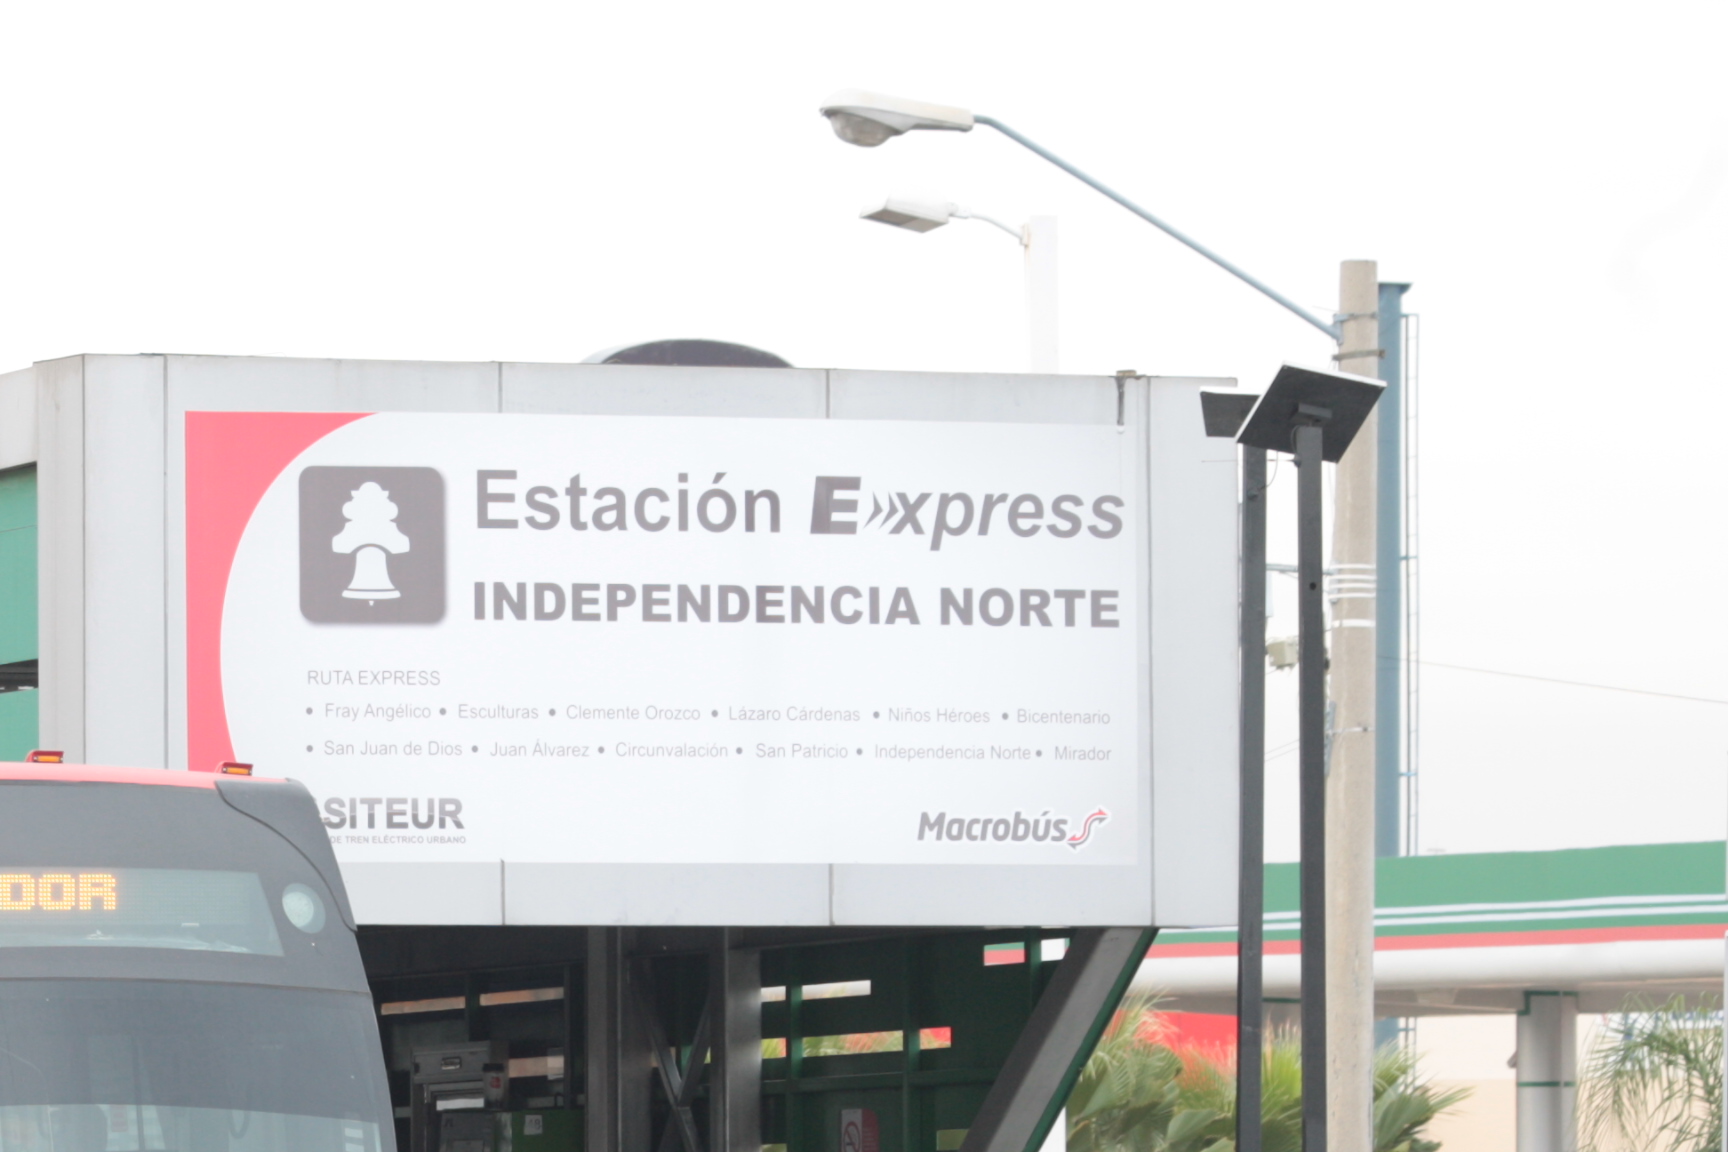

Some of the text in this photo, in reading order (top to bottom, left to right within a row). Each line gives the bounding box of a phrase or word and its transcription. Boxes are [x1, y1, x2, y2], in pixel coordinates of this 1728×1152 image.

[475, 468, 782, 534] Estación
[473, 581, 1121, 630] INDEPENDENCIA NORTE
[307, 669, 441, 686] RUTA EXPRESS
[324, 702, 432, 722] Fray Angélico
[457, 703, 540, 720] Esculturas
[565, 704, 702, 721] Clemente Orozco
[728, 705, 861, 722] Lázaro Cárdenas
[888, 706, 991, 724] Niños Héroes
[1016, 708, 1112, 725] Bicentenario
[323, 739, 463, 757] San Juan de Dios
[489, 738, 590, 758] Juan Álvarez
[615, 741, 729, 759] Circunvalación
[755, 742, 849, 759] San Patricio
[874, 743, 1032, 763] Independencia Norte
[1054, 745, 1113, 762] Mirador
[323, 797, 465, 831] SITEUR
[917, 809, 1068, 843] Macrobús
[345, 836, 370, 845] TREN
[372, 834, 424, 845] ELÉCTRICO
[426, 836, 467, 845] URBANO
